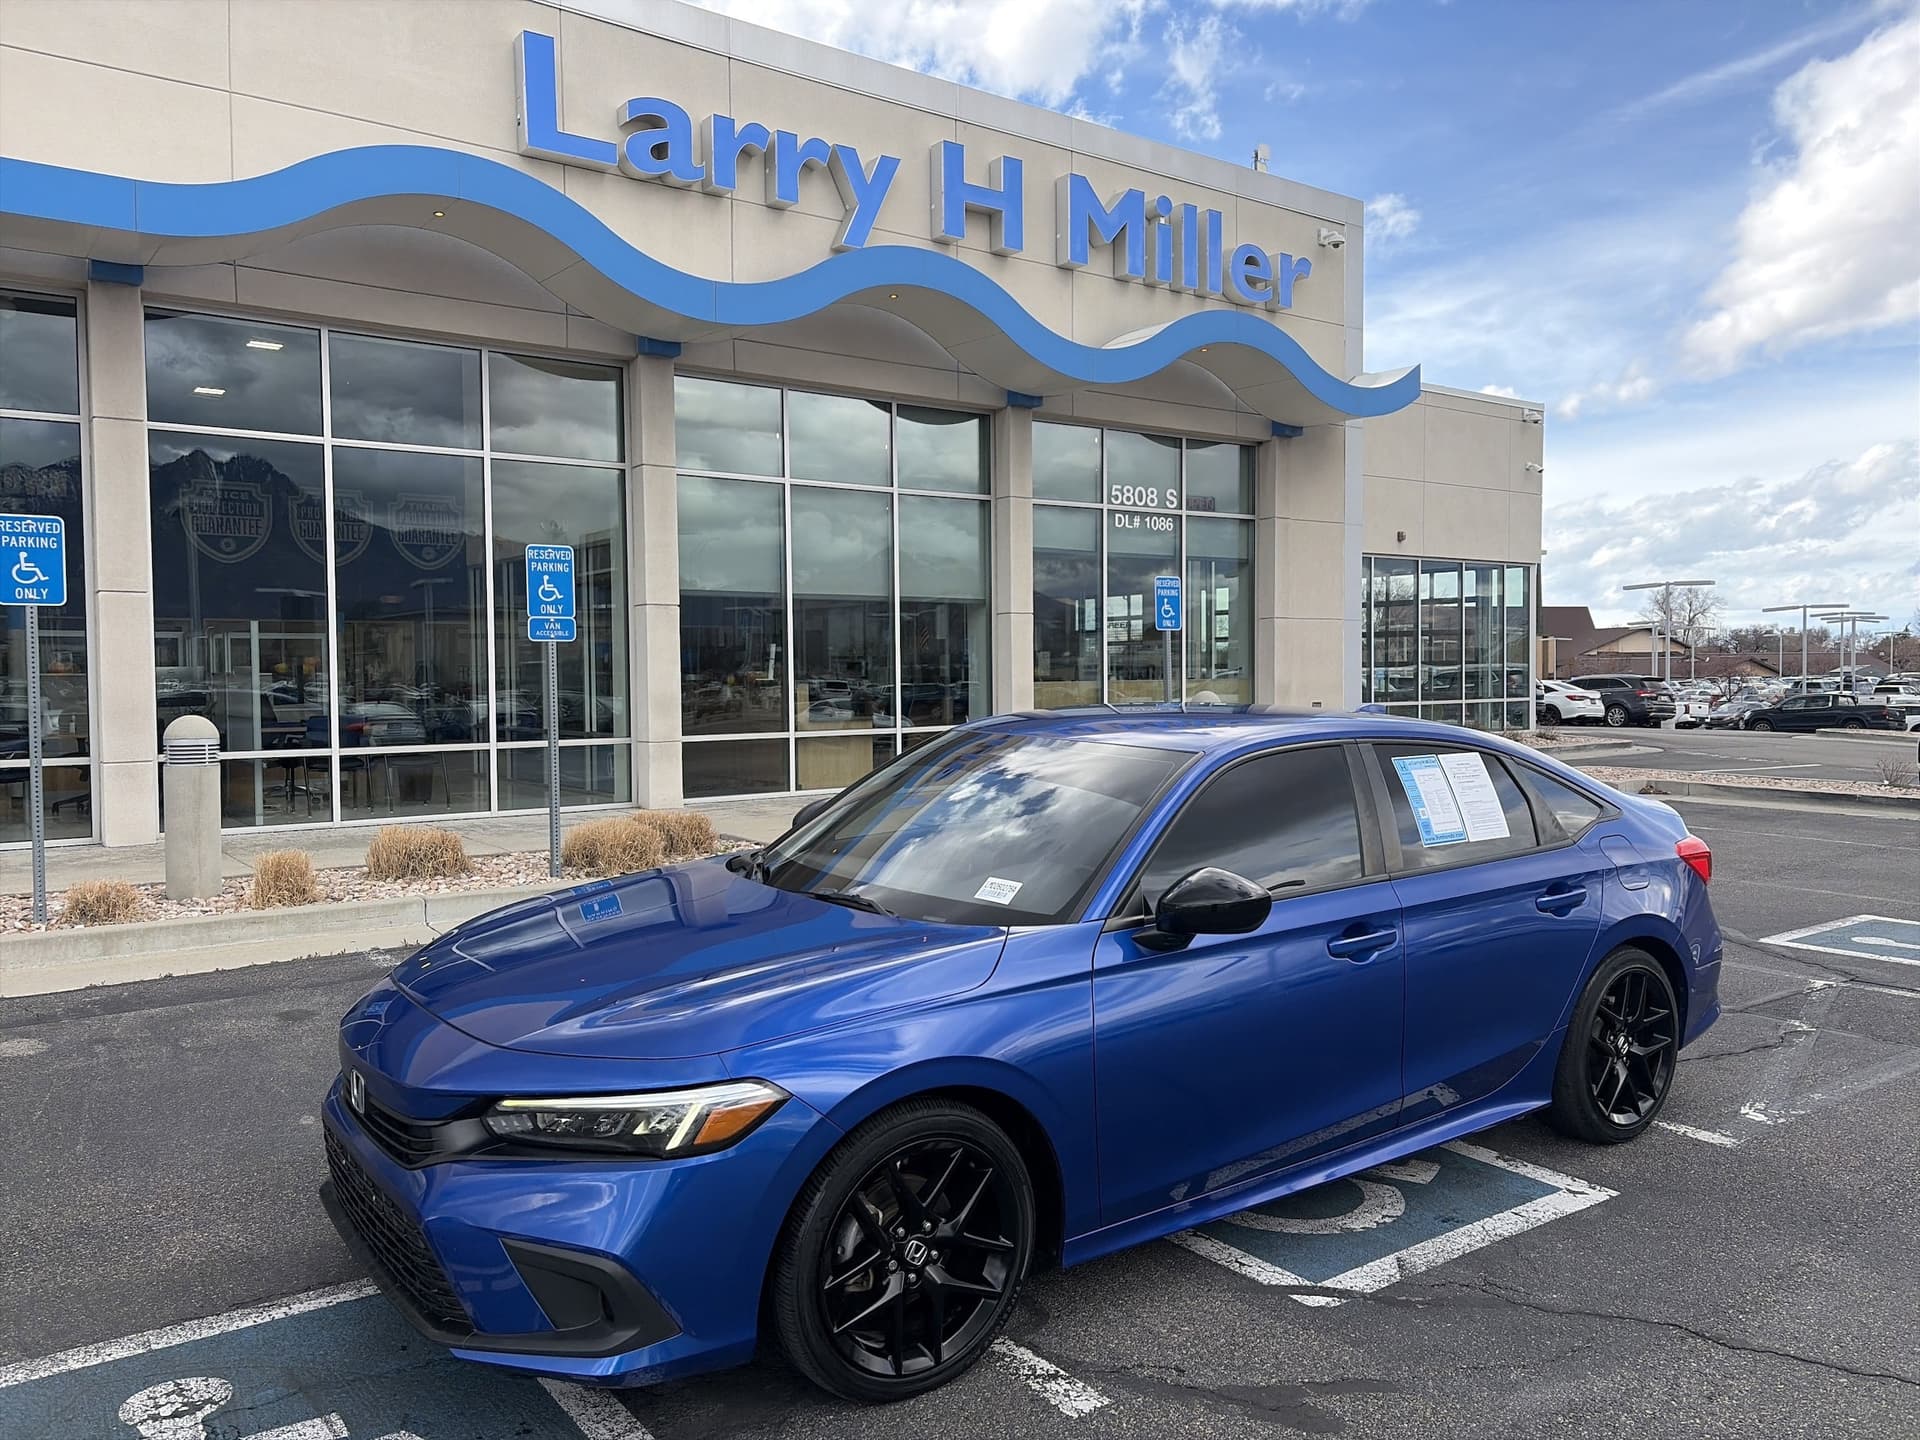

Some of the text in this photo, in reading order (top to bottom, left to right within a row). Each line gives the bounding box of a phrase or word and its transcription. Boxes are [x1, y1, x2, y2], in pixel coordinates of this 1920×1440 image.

[513, 29, 1312, 311] Larry H Miller
[1111, 484, 1178, 508] 5808 S
[0, 520, 60, 534] RESERVED
[192, 516, 264, 536] GUARANTEE
[1115, 513, 1173, 531] DL# 1086
[300, 521, 364, 540] GUANTEE
[2, 536, 57, 549] PARKING
[528, 549, 571, 561] RESERVED
[531, 562, 569, 572] PARKING
[15, 588, 48, 599] ONLY
[1158, 588, 1179, 596] PARKING
[540, 604, 564, 614] ONLY
[544, 622, 561, 630] VAN
